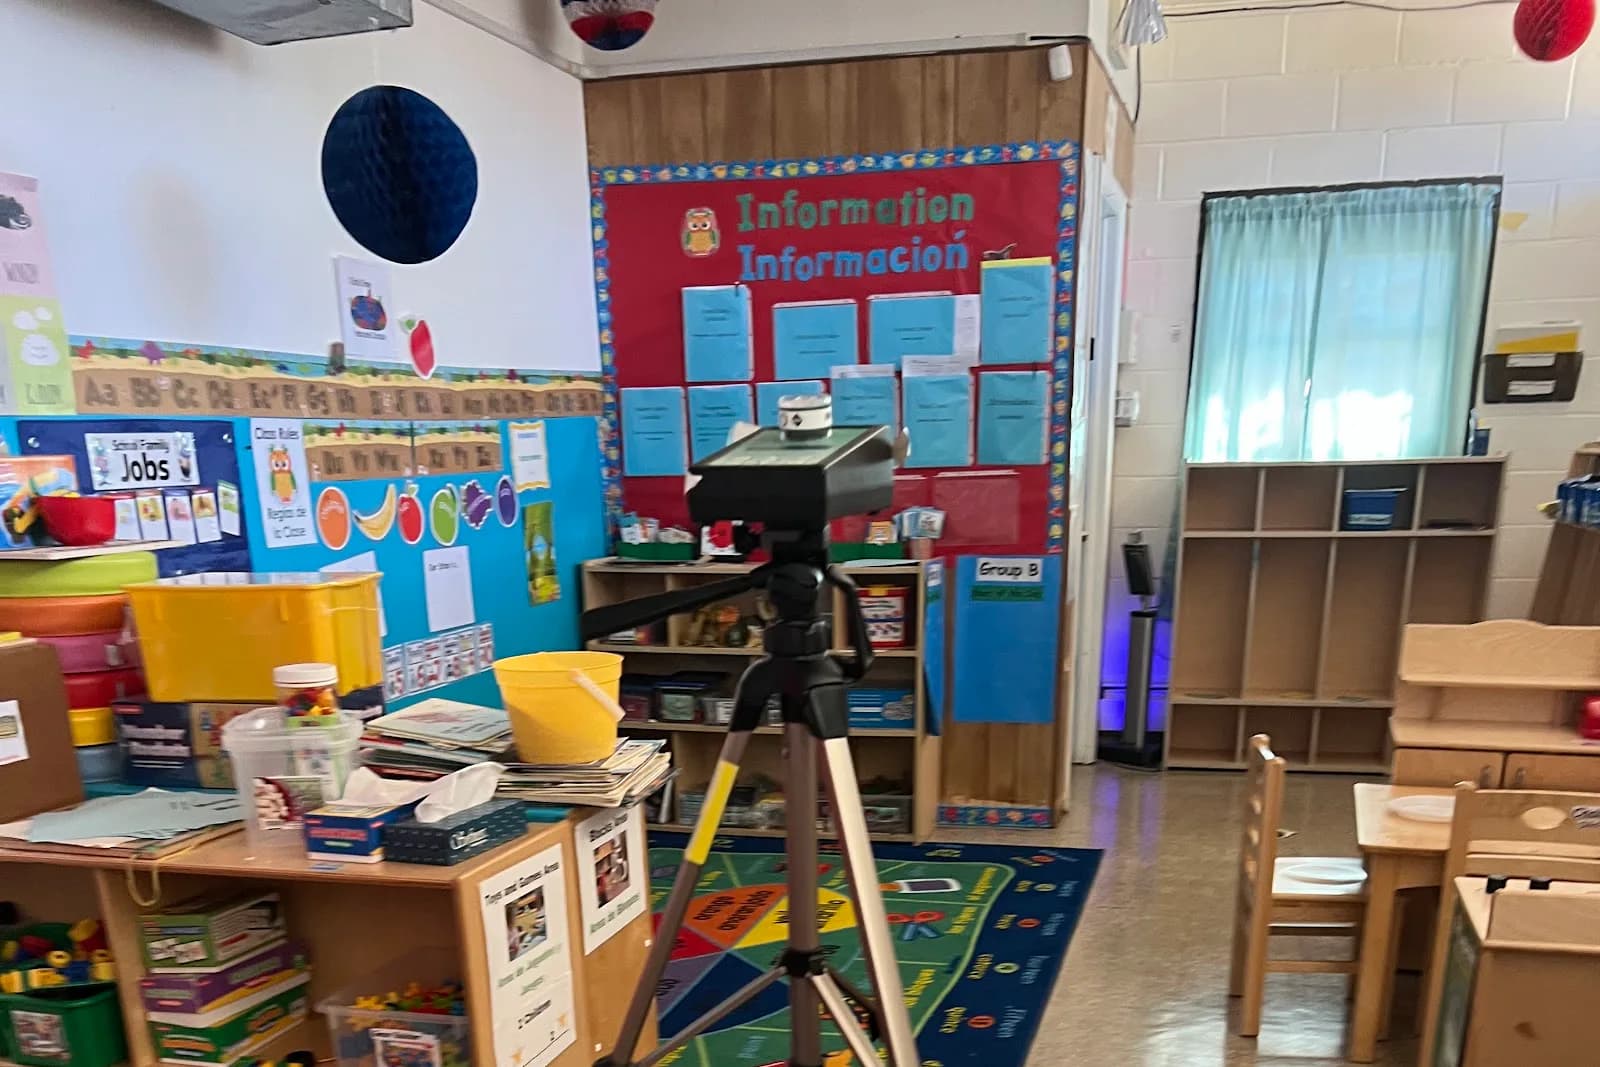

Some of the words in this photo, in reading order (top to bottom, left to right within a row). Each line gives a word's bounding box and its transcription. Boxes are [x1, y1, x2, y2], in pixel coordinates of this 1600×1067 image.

[736, 187, 974, 232] Information
[121, 452, 170, 482] Jobs
[979, 561, 1023, 580] Group
[1029, 562, 1040, 577] B
[692, 896, 735, 921] orange
[716, 890, 775, 932] anaranjado
